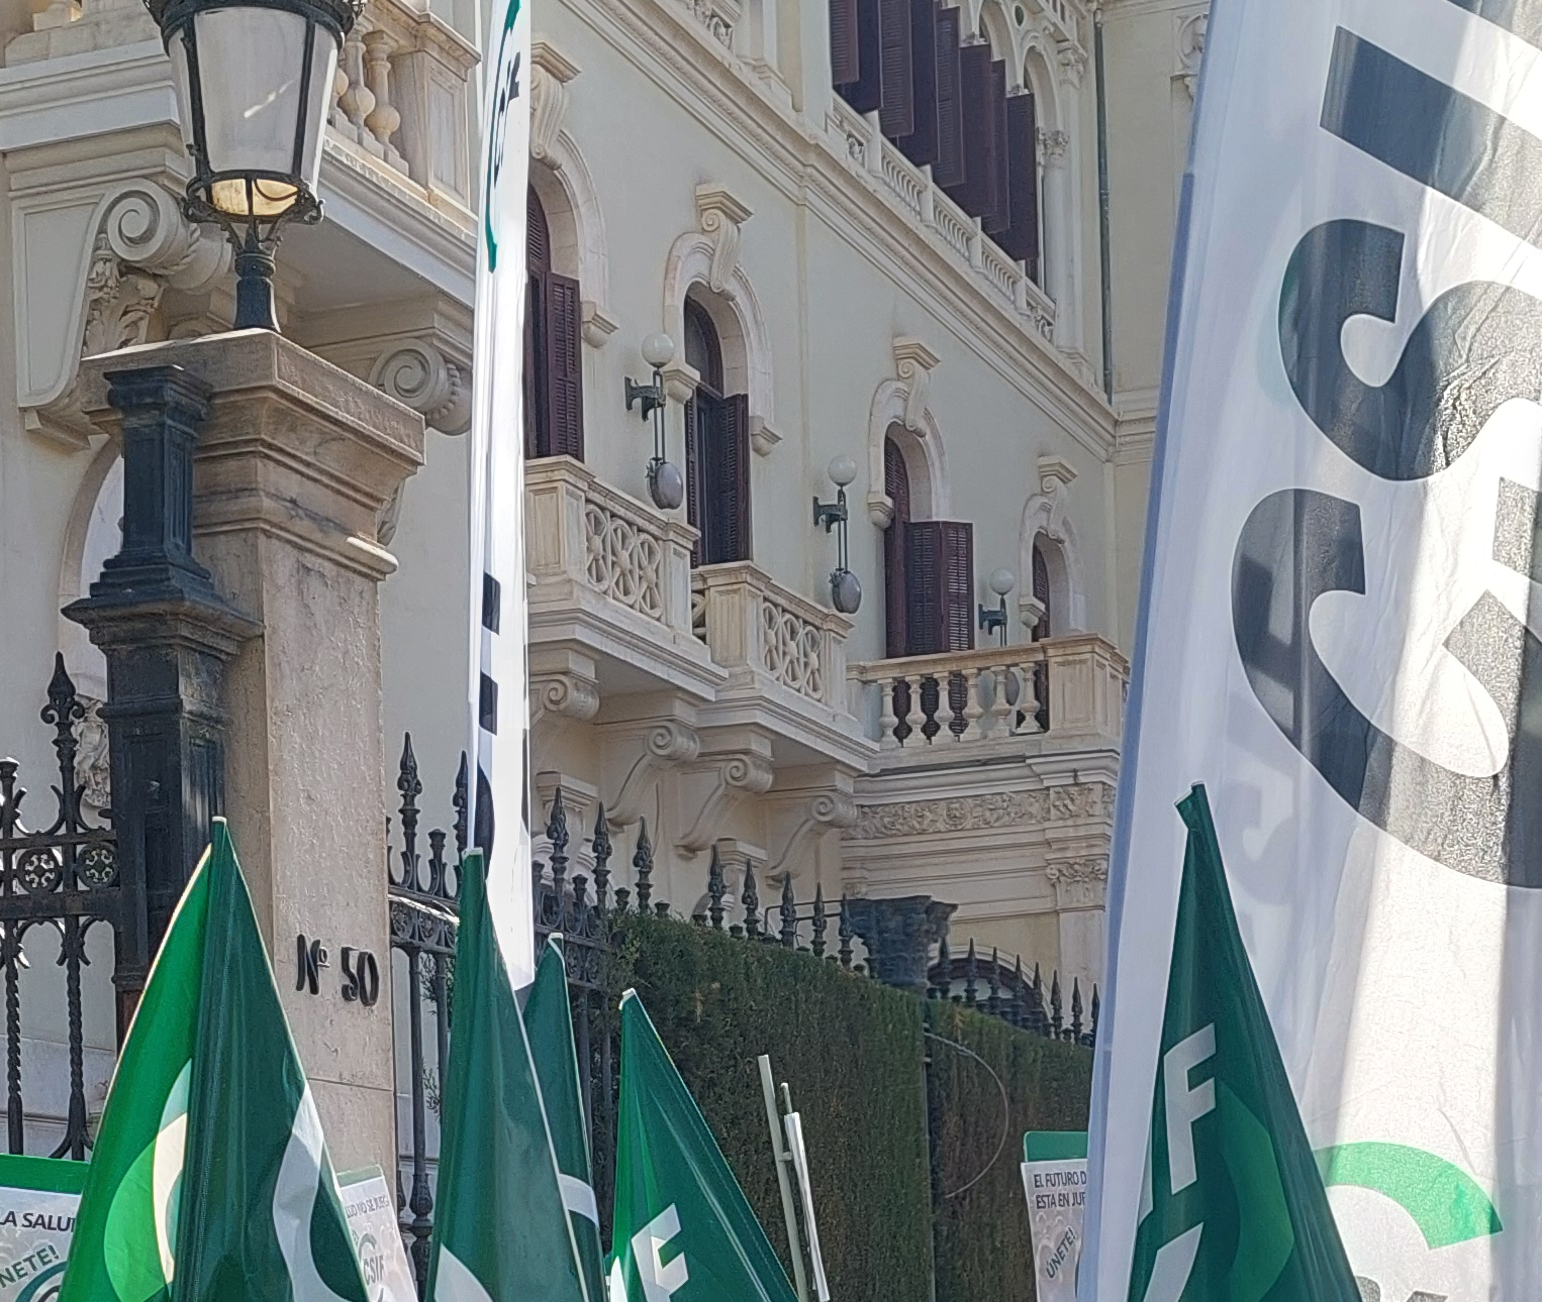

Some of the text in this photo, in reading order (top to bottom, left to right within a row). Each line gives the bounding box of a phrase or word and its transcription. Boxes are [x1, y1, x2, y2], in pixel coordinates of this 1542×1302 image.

[341, 946, 379, 1007] 50
[1033, 1174, 1043, 1188] EL
[1045, 1171, 1079, 1188] FUTURO
[1035, 1194, 1057, 1210] ESTA
[1059, 1193, 1070, 1208] EN
[1046, 1227, 1077, 1279] ÚNETE!
[363, 1254, 385, 1286] CSIF
